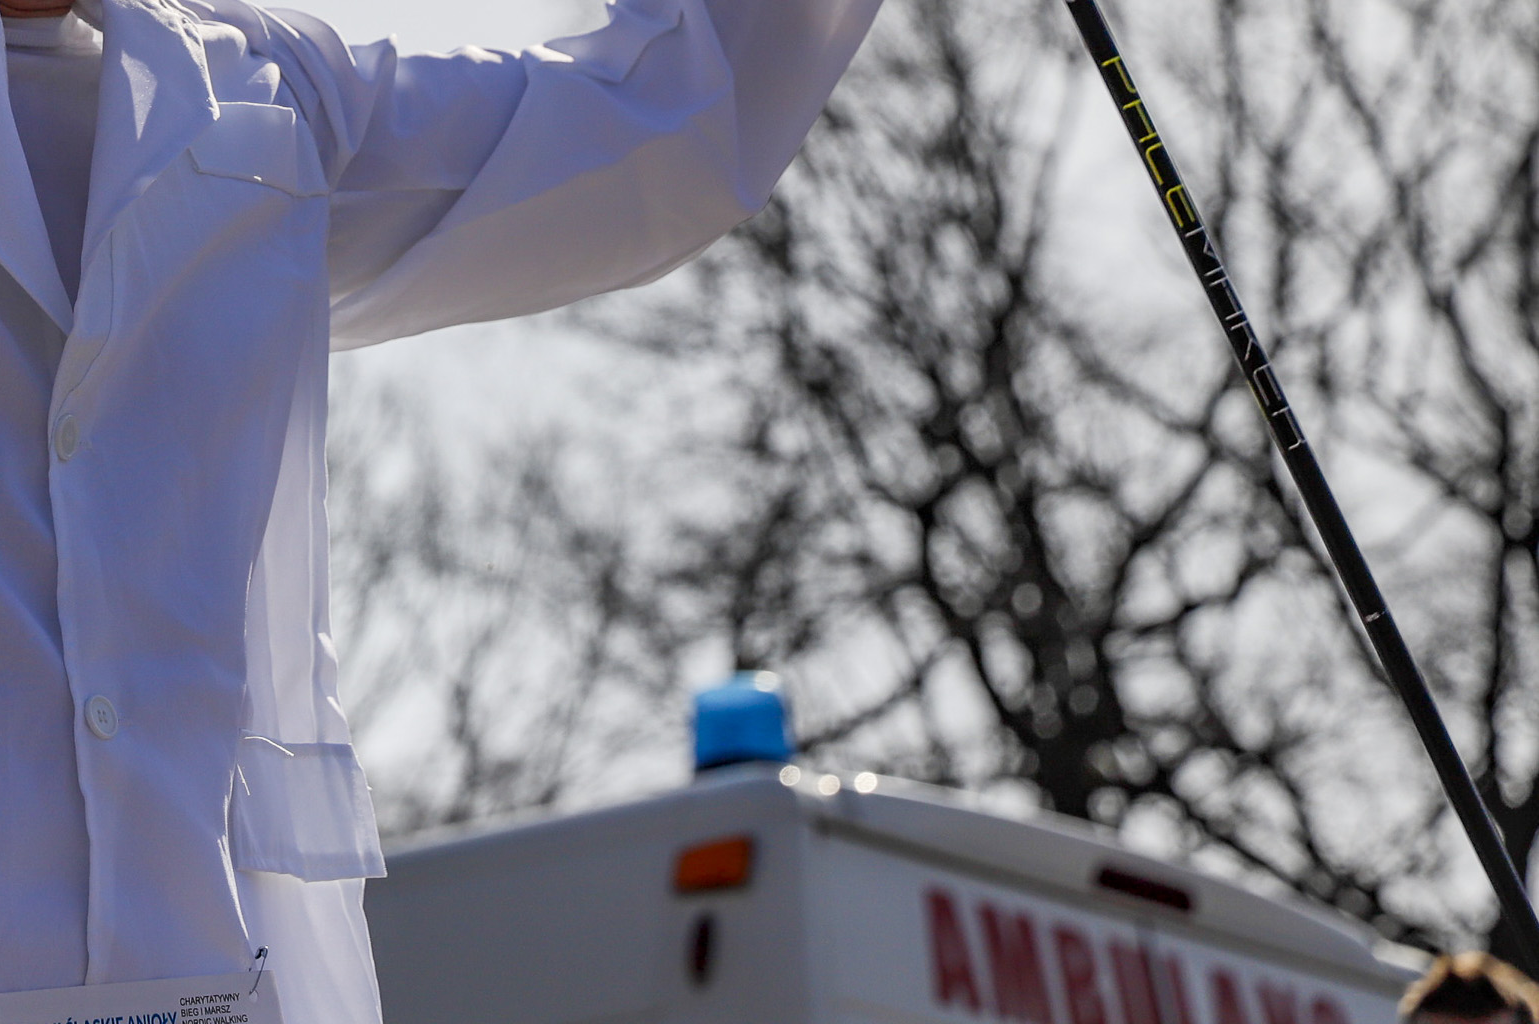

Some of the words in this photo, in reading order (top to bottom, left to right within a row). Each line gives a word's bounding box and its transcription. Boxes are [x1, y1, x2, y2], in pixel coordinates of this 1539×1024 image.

[179, 993, 240, 1006] CHARYTATYWNY
[181, 1008, 199, 1017] BIEG
[204, 1005, 231, 1015] MARSZ
[213, 1014, 248, 1024] WALKING
